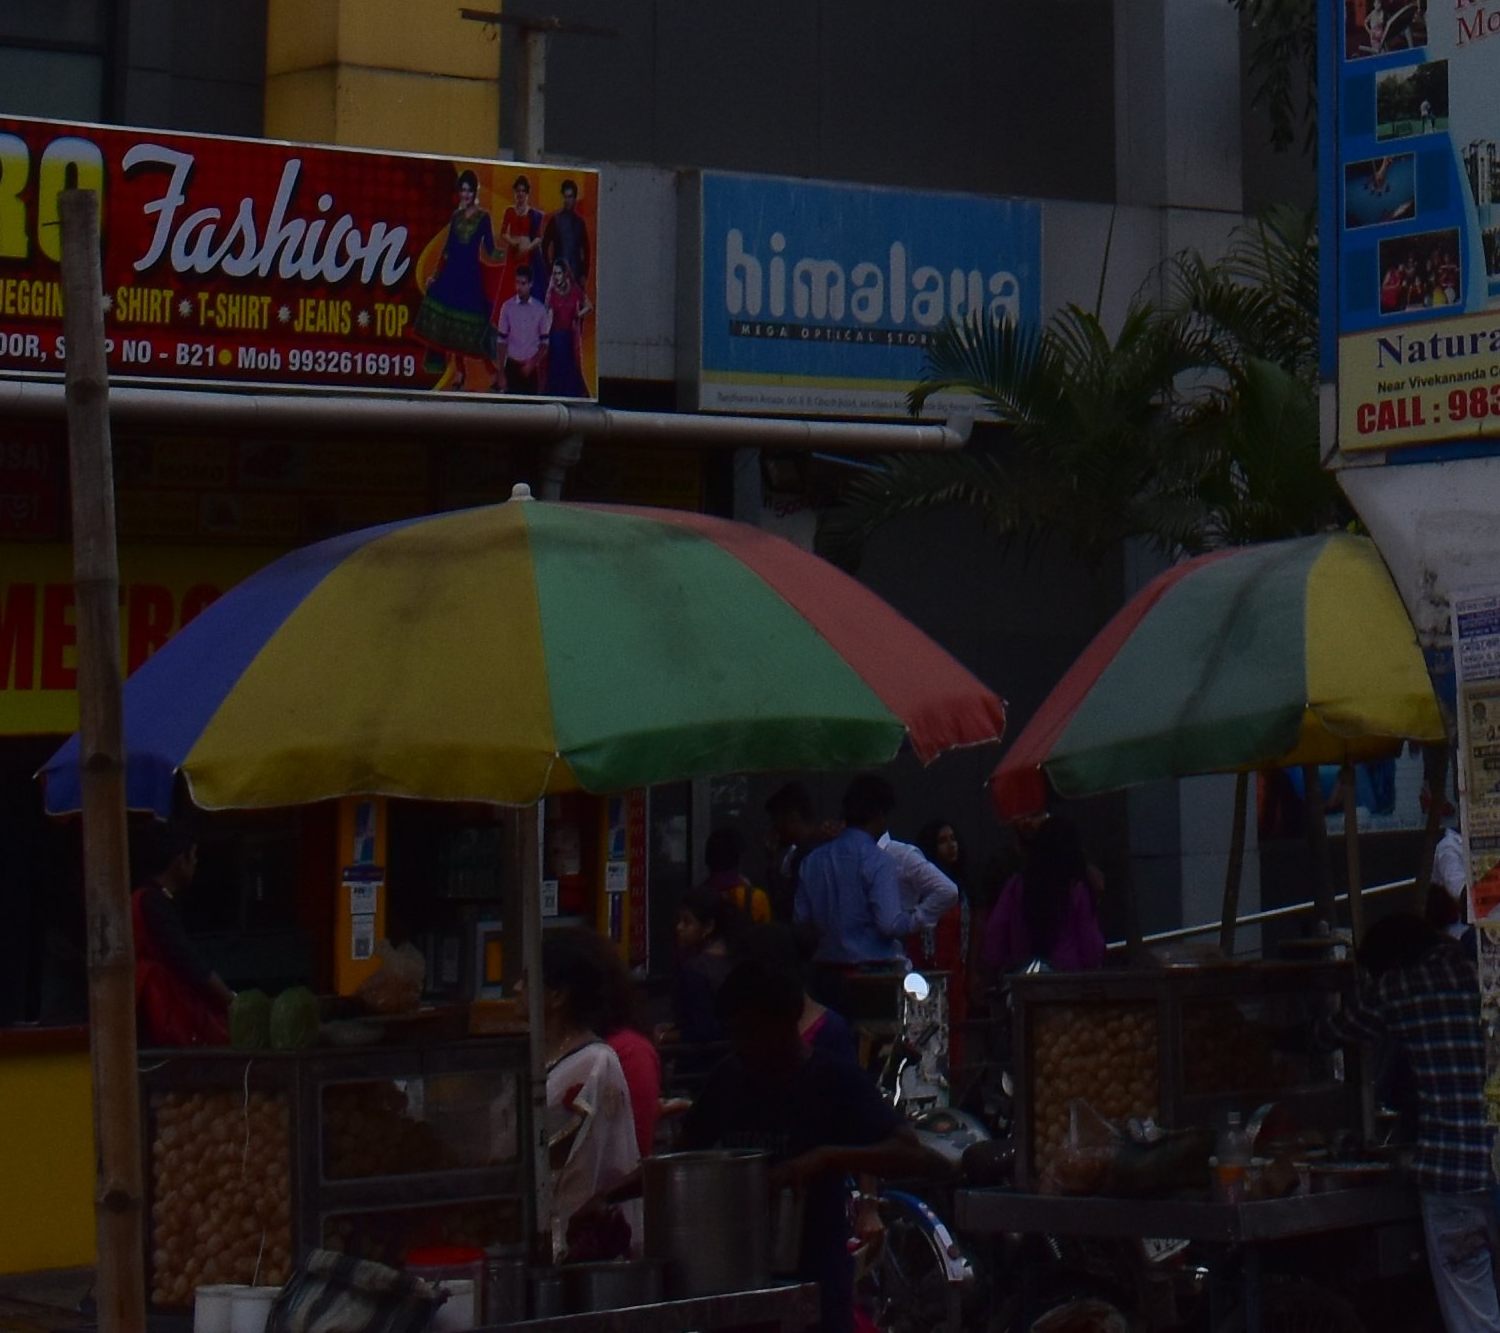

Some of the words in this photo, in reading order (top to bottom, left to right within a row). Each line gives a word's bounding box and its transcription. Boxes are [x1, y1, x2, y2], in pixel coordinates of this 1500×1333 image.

[120, 143, 411, 286] Fashion
[726, 227, 1021, 343] himalaya
[116, 285, 174, 325] SHIRT
[198, 291, 273, 331] T-SHIRT
[293, 296, 352, 336] JEANS
[374, 301, 410, 340] TOP
[741, 324, 787, 337] MEGA
[801, 327, 874, 342] OPTICAL
[121, 339, 152, 365] NO
[175, 342, 216, 368] B21
[237, 346, 282, 371] Mob
[287, 348, 416, 377] 9932616919
[1378, 381, 1405, 394] Near
[1408, 370, 1486, 390] Vivekananda
[1357, 396, 1425, 434] CALL
